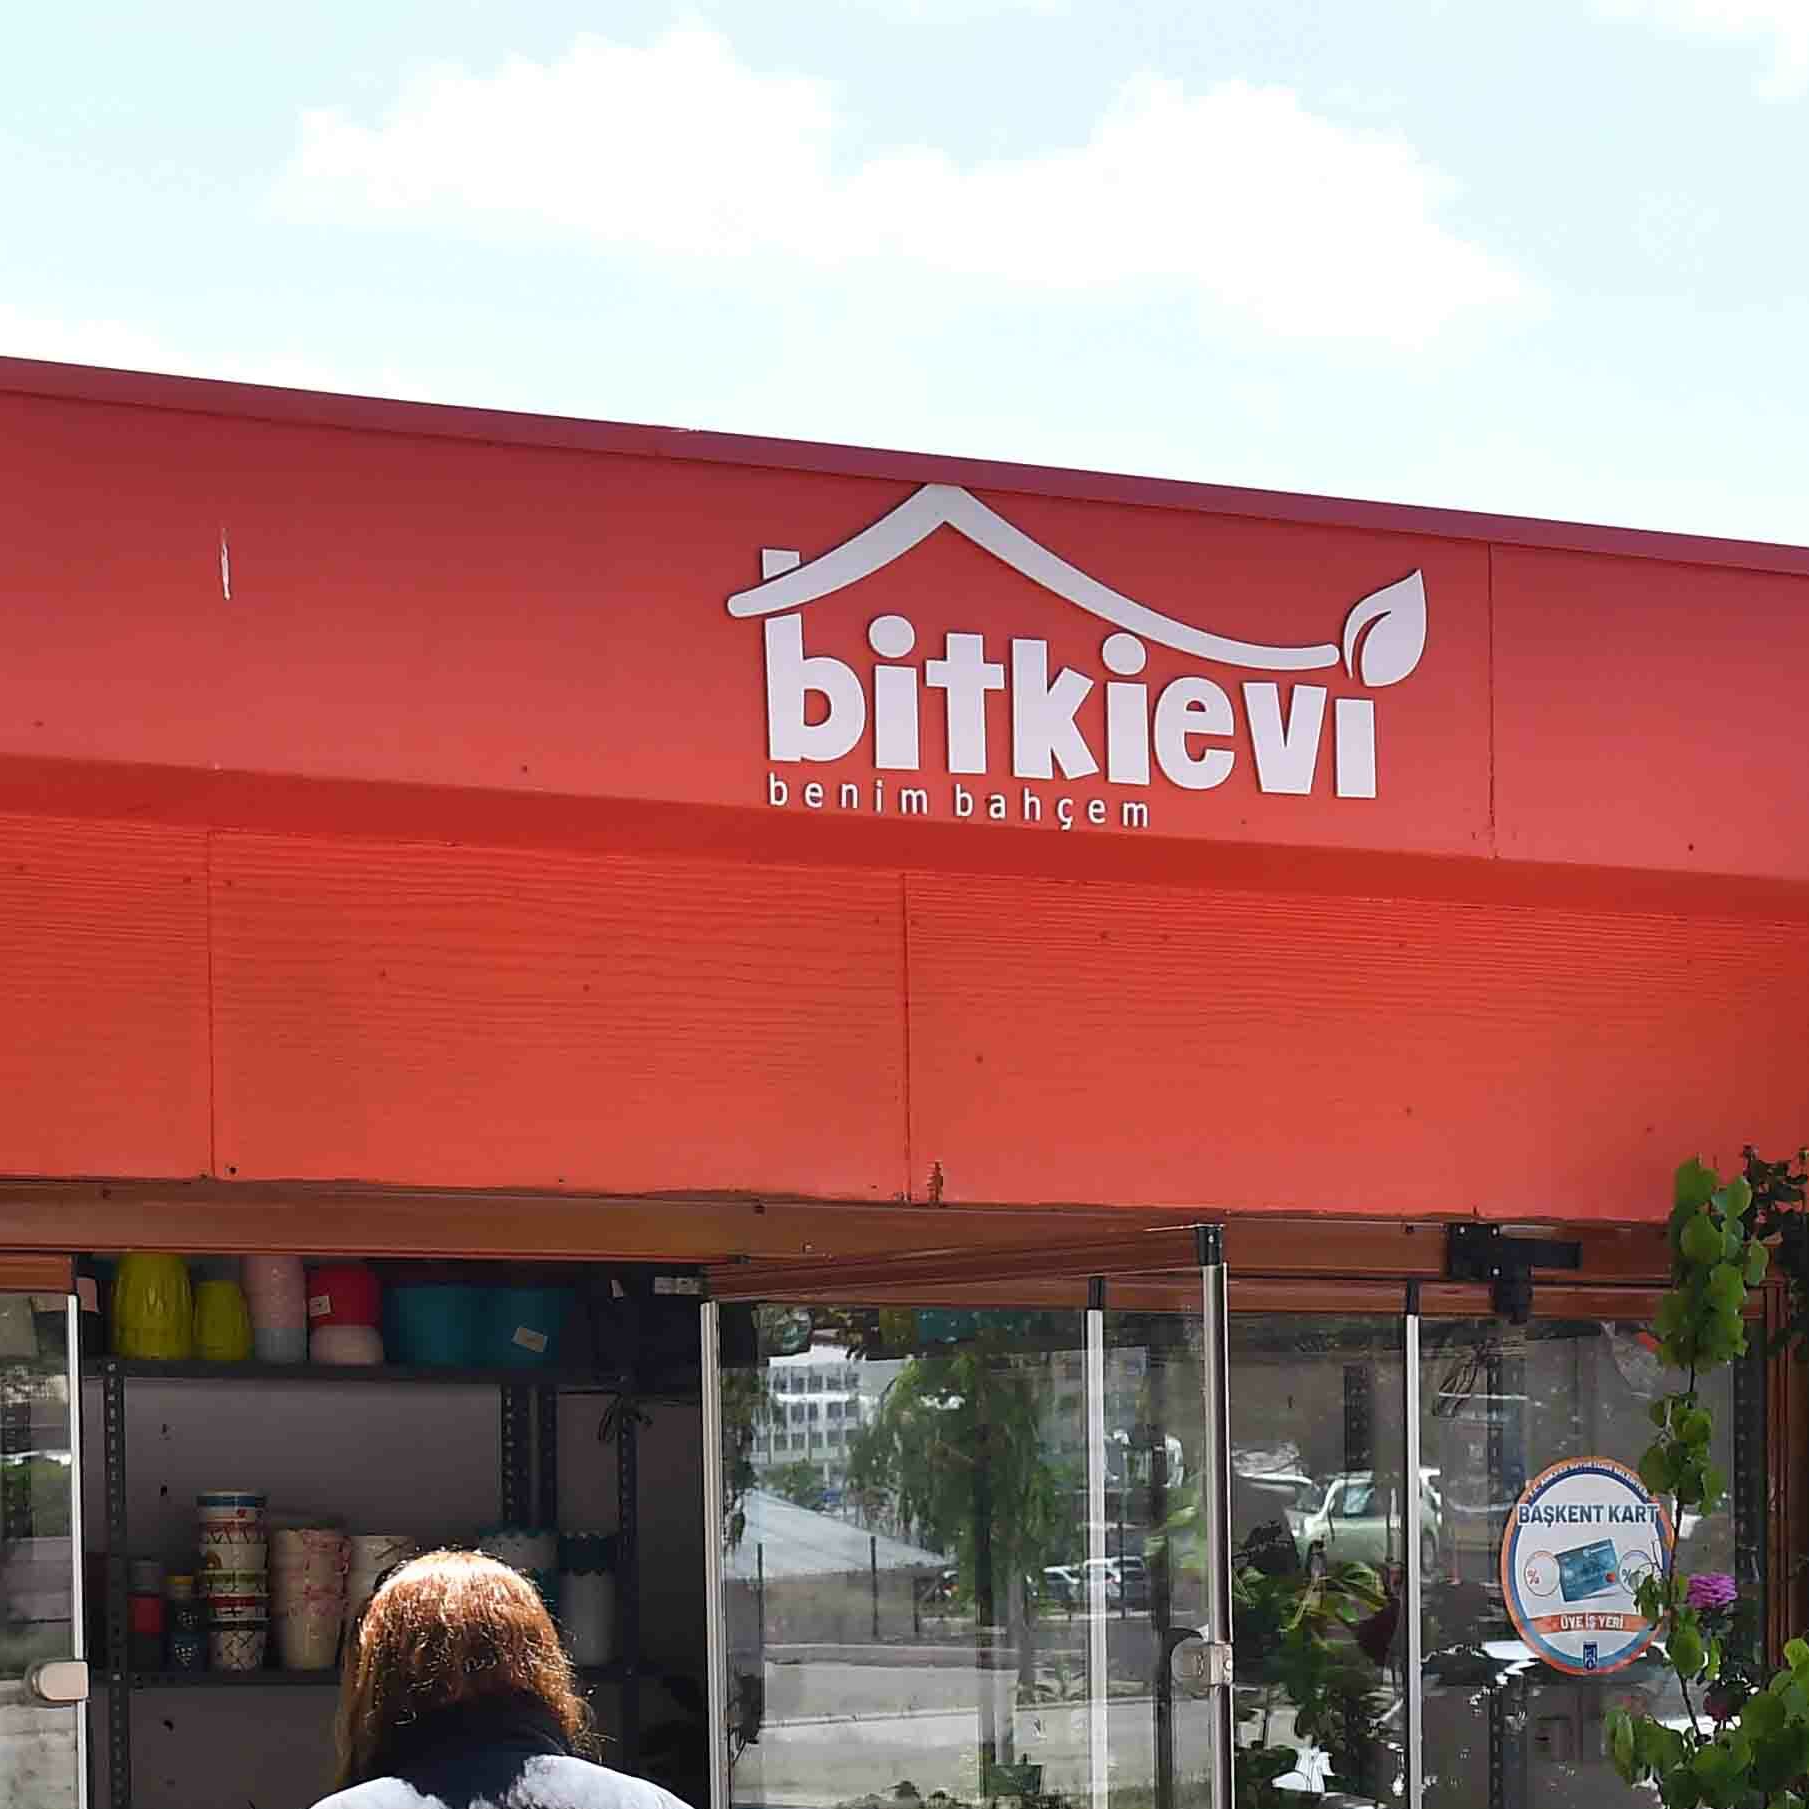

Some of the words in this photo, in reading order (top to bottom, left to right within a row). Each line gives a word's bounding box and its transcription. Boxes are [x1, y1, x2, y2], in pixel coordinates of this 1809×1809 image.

[764, 613, 1377, 798] bitkievi
[768, 773, 928, 816] benim
[954, 784, 1150, 830] bahçem
[1518, 1504, 1604, 1528] BAŞKENT
[1608, 1503, 1659, 1524] KART
[1560, 1614, 1584, 1630] ÜYE
[1597, 1613, 1624, 1630] YERİ
